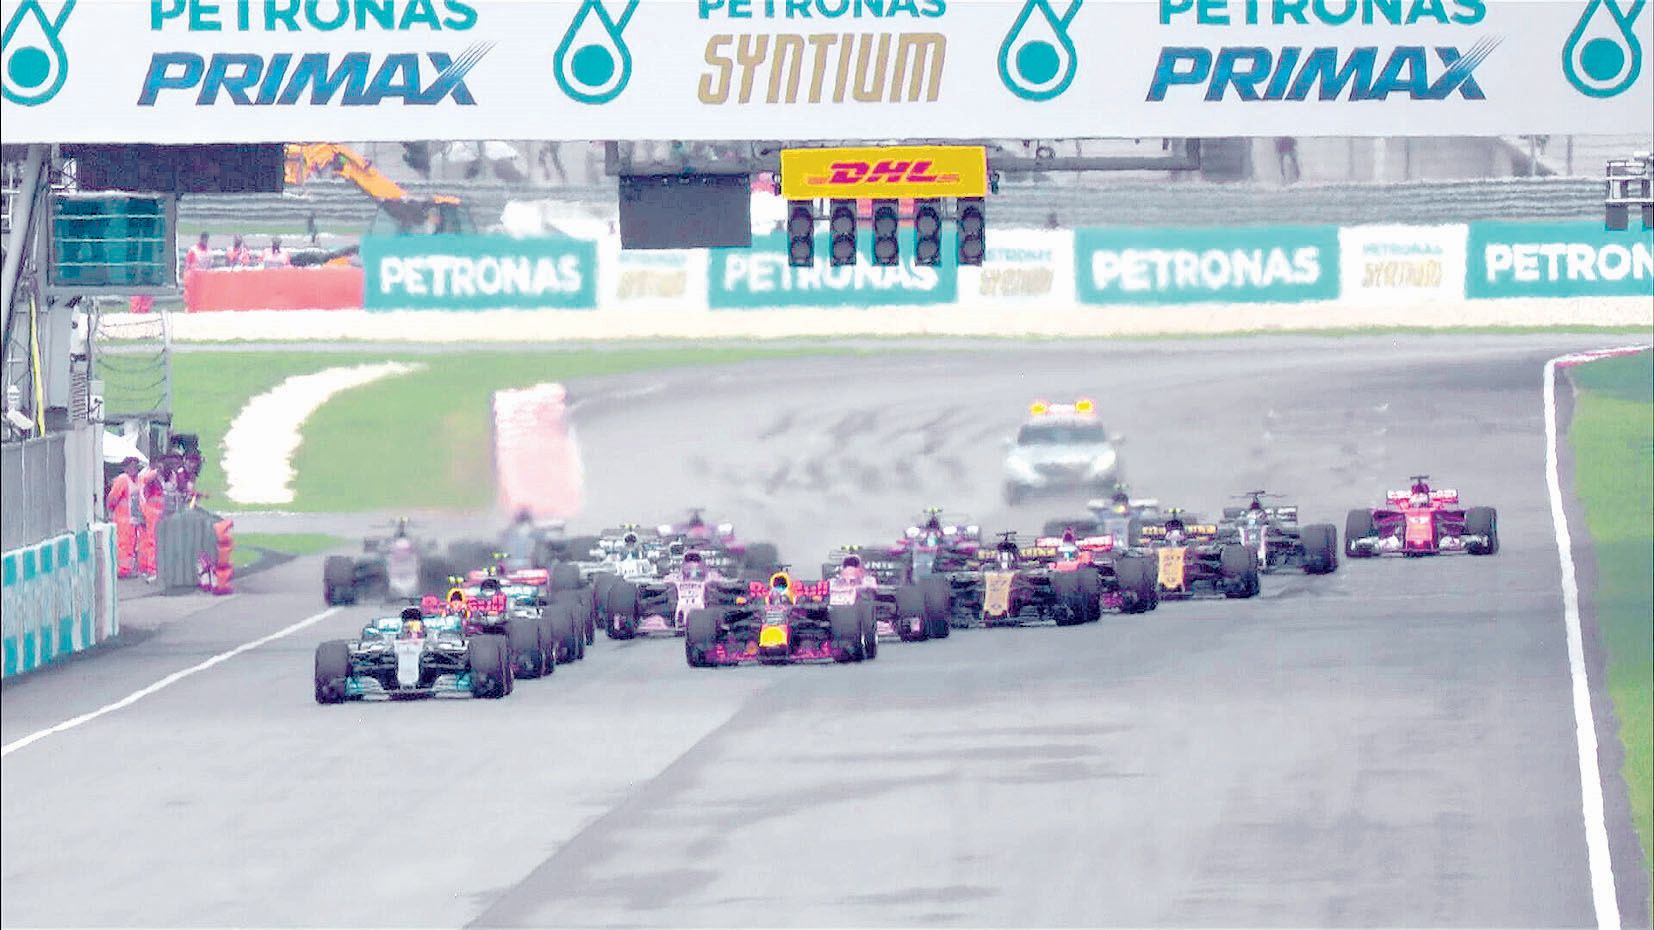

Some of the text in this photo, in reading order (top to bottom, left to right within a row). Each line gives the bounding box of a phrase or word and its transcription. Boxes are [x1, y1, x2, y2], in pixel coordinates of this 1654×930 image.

[150, 0, 478, 31] PETRONAS
[698, 0, 947, 19] PETRONAS
[1158, 0, 1487, 25] PETRONAS
[139, 41, 496, 106] PRIMAX
[697, 33, 947, 104] SYNTIUM
[1145, 36, 1504, 102] PRIMAX
[828, 160, 940, 185] DHL
[380, 254, 583, 296] PETRONAS
[725, 253, 939, 291] PETRONAS
[1092, 246, 1320, 291] PETRONAS
